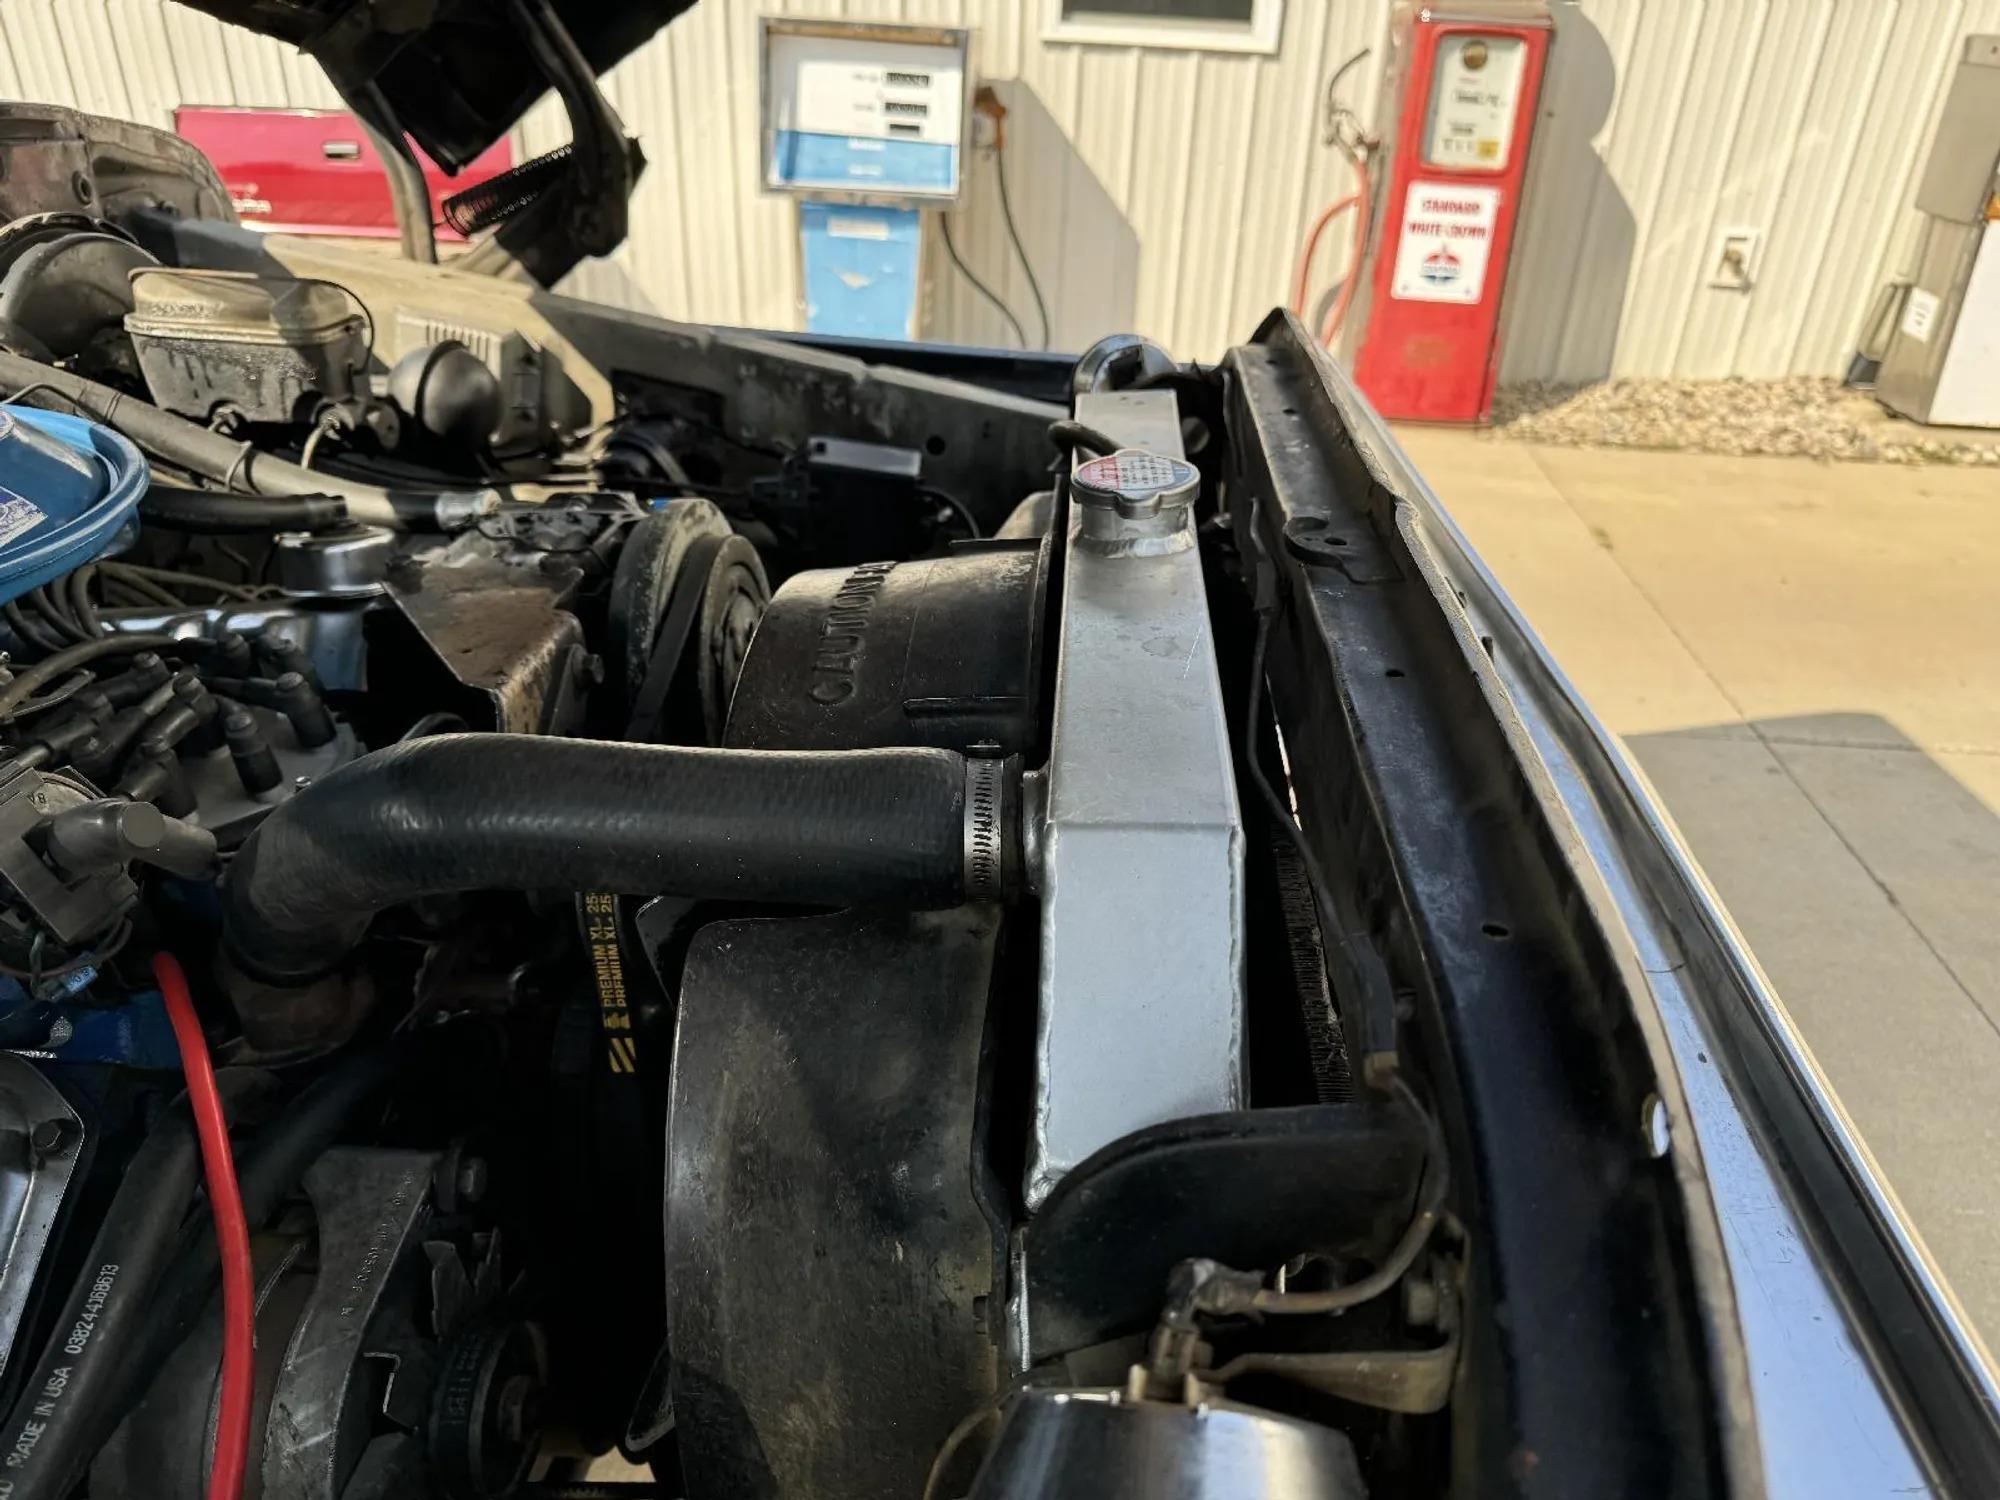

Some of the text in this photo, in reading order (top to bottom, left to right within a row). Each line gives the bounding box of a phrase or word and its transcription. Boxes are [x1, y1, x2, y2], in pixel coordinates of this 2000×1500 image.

[808, 575, 886, 704] CAUTION
[592, 944, 616, 1007] PREMIUM
[42, 1366, 73, 1398] USA
[33, 1400, 56, 1417] IN
[6, 1420, 47, 1469] MADE
